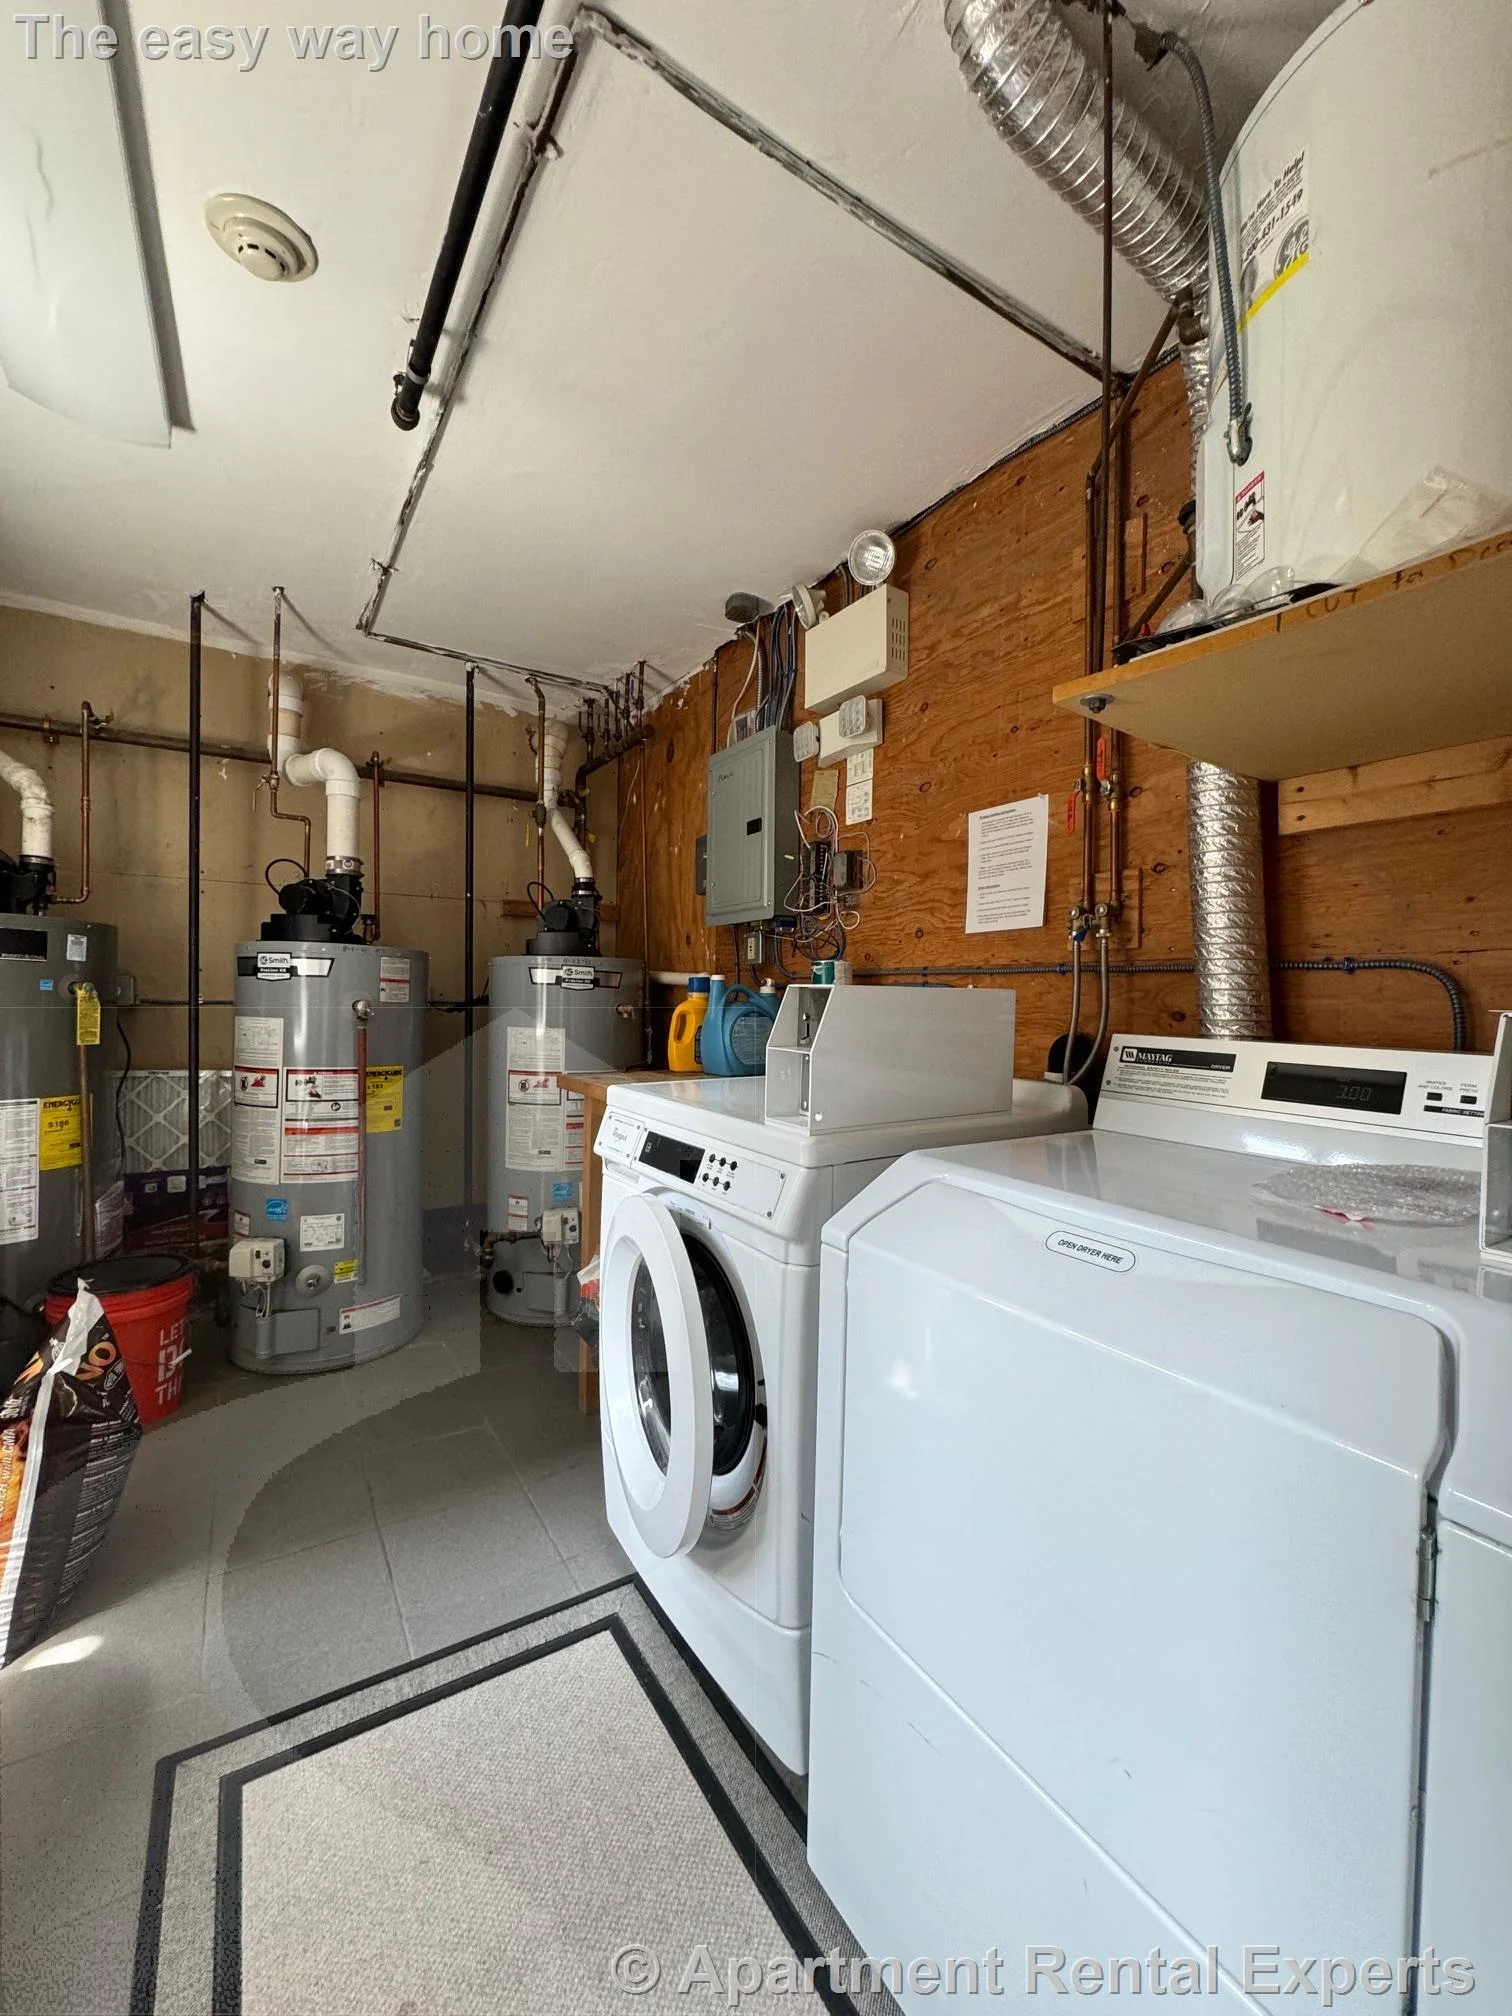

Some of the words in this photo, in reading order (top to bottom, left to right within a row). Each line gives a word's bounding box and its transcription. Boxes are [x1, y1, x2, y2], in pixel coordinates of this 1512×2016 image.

[1137, 1052, 1173, 1063] MAYTAG
[1057, 1238, 1077, 1250] OPEN
[1077, 1244, 1102, 1258] DRYER
[1101, 1252, 1124, 1265] HERE
